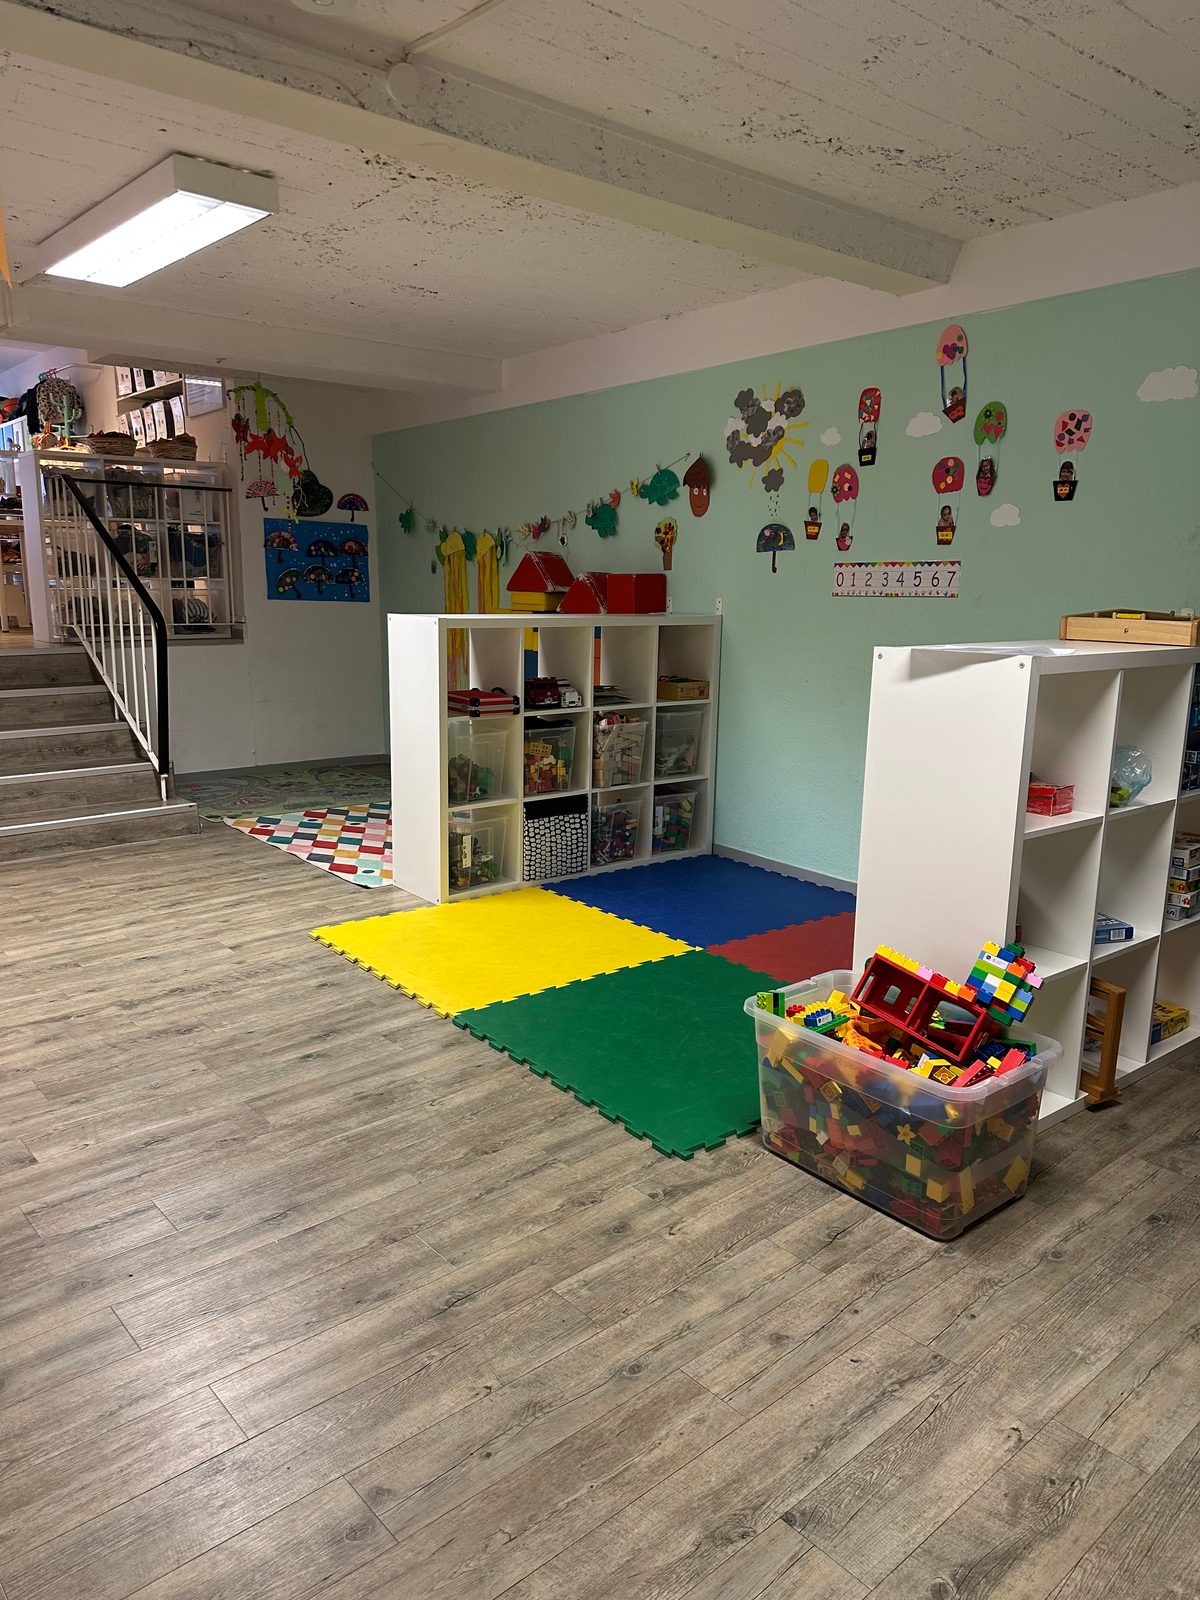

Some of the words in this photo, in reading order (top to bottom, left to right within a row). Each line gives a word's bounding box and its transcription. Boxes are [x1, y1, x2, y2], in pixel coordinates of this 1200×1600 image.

[836, 572, 844, 587] 0
[850, 572, 856, 587] 1
[865, 572, 873, 587] 2
[881, 572, 889, 587] 3
[896, 571, 905, 587] 4
[913, 571, 922, 587] 5
[931, 571, 940, 587] 6
[947, 571, 957, 587] 7
